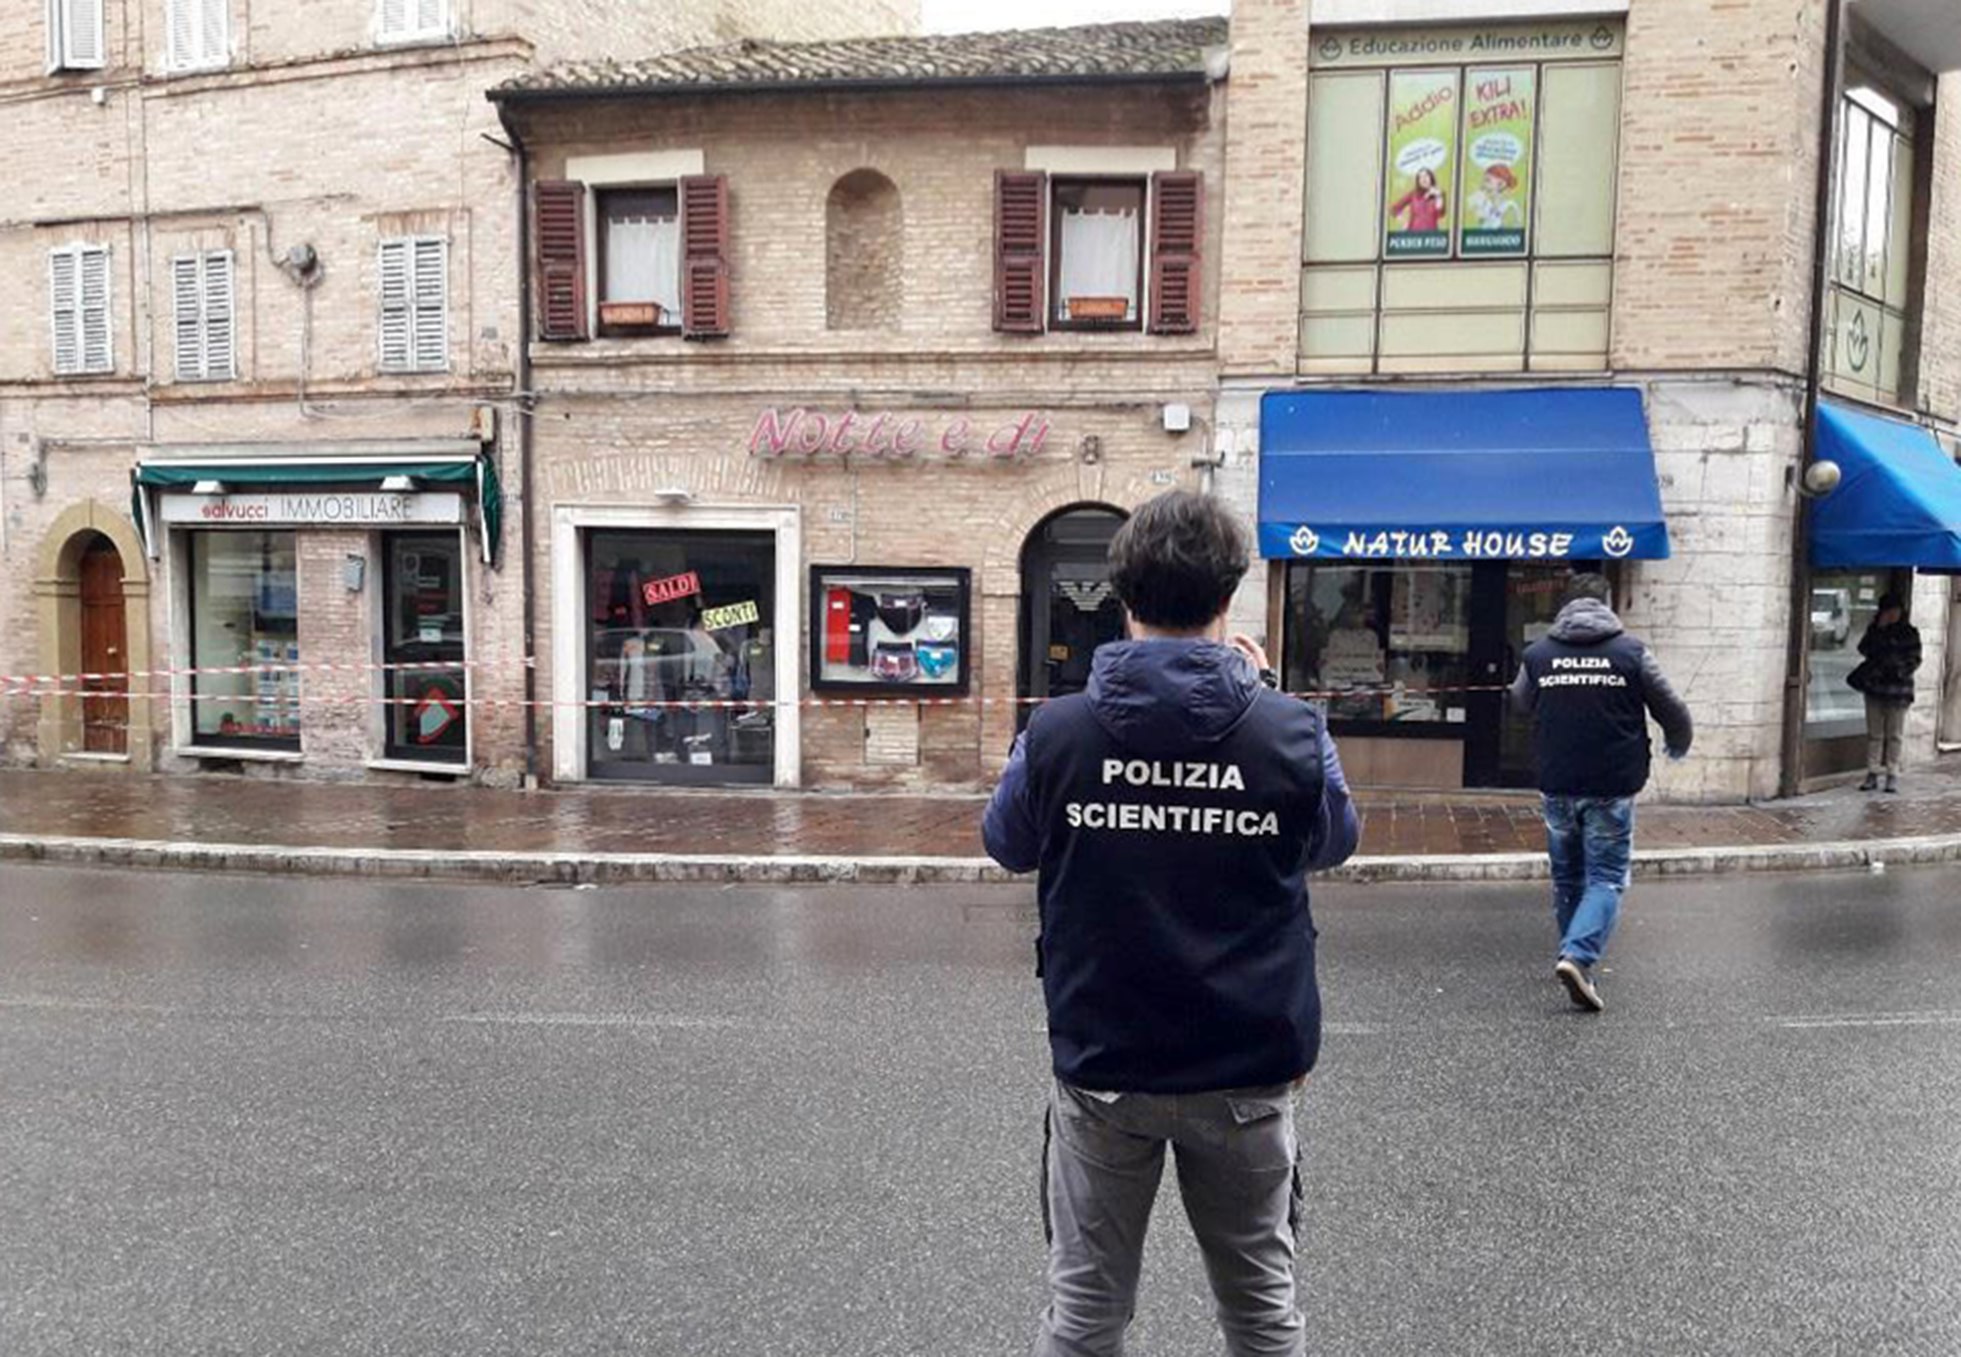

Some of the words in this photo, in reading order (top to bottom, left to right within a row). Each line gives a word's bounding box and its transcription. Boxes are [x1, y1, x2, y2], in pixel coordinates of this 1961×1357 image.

[1350, 37, 1463, 56] Educazione
[1469, 32, 1582, 51] Alimentare
[1469, 99, 1527, 129] EXTRA!
[750, 408, 921, 455] Notte
[941, 417, 969, 455] e
[201, 497, 269, 519] salvucci
[280, 496, 414, 520] IMMOBILIARE
[1342, 530, 1452, 556] NATUR
[1462, 529, 1574, 557] HOUSE
[644, 573, 698, 602] SALDI
[703, 602, 757, 628] SCONTI
[1552, 657, 1611, 670] POLIZIA
[1538, 673, 1627, 688] SCIENTIFICA
[1102, 758, 1246, 791] POLIZIA
[1065, 802, 1280, 836] SCIENTIFICA
